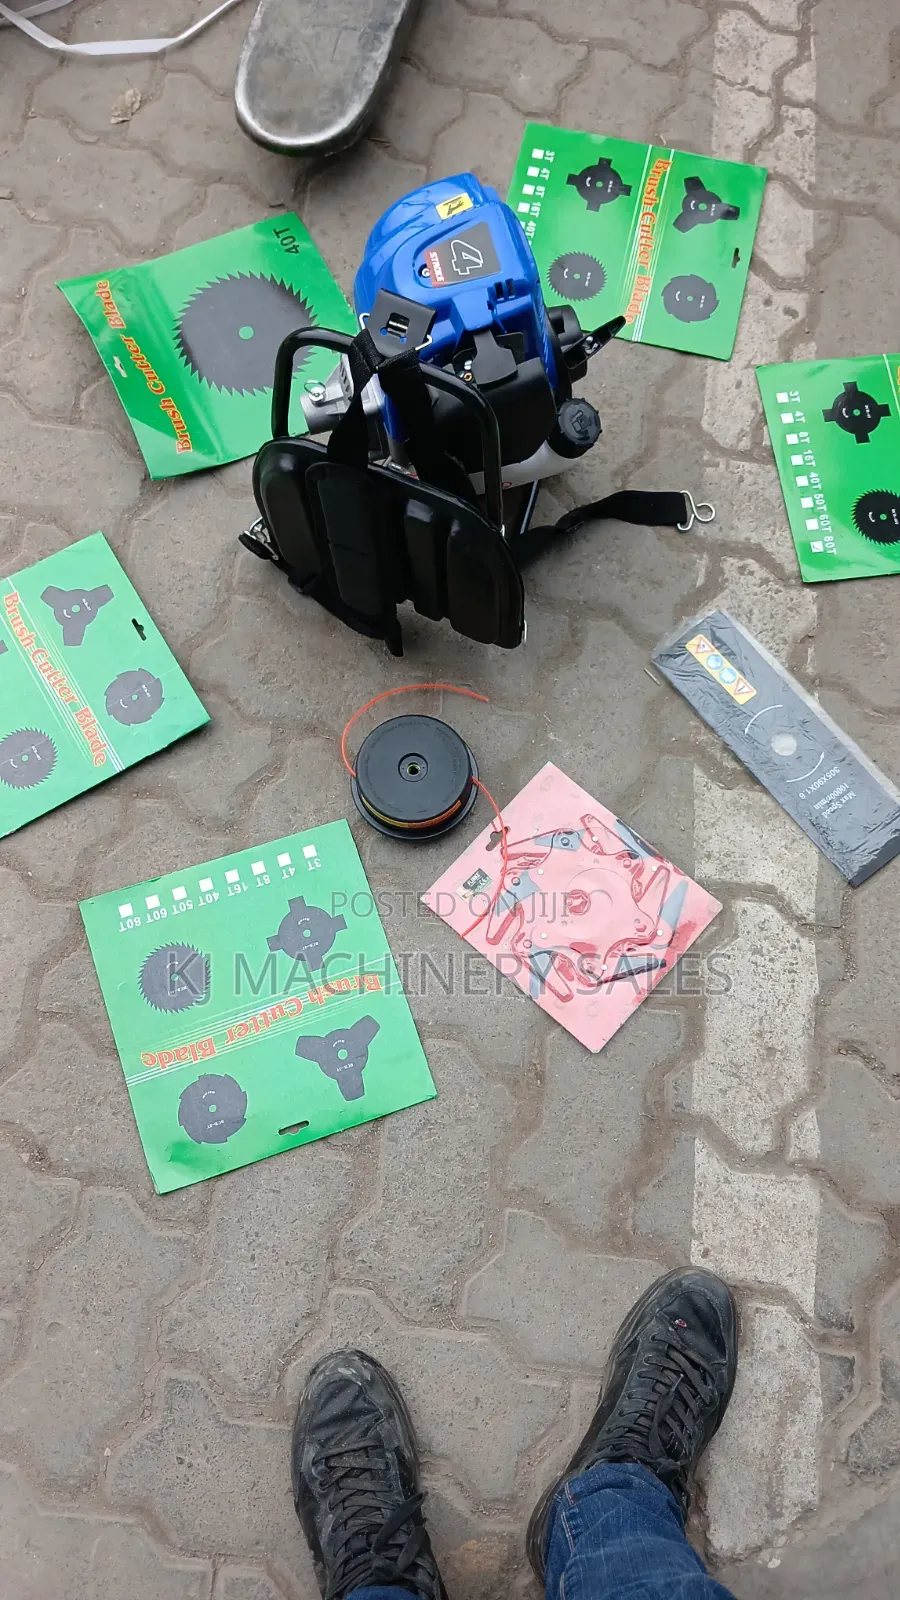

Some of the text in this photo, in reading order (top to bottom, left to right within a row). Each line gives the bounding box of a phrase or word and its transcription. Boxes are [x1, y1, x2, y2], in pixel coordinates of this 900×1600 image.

[525, 150, 555, 238] 3T 4T 8T 16T 40T
[273, 226, 300, 256] 40T
[429, 251, 444, 282] STROKE
[450, 239, 484, 276] 4
[625, 158, 672, 324] Brush Cutter Blade
[95, 280, 193, 454] Brush Cutter Blade
[789, 390, 837, 556] 3T 4T 8T 16T 40T 50T 60T 80T
[3, 591, 108, 768] Brush Cutter Blade
[798, 766, 840, 800] 305X90X1.6
[822, 790, 857, 819] Max Speed
[118, 858, 322, 933] 3T 4T 8T 16T 40T 50T 60T 80T
[140, 974, 382, 1070] Brush Cutter Blade
